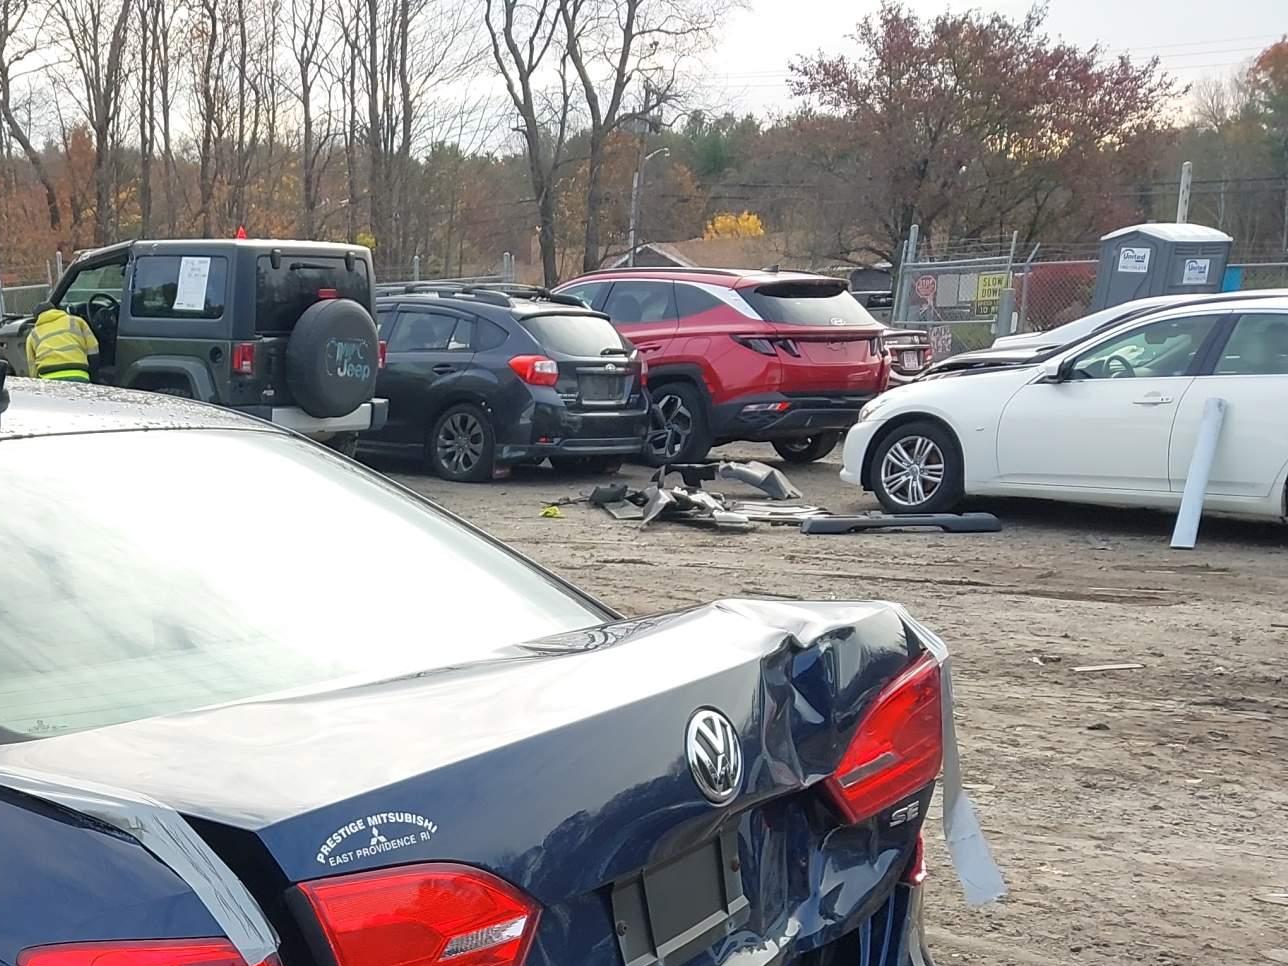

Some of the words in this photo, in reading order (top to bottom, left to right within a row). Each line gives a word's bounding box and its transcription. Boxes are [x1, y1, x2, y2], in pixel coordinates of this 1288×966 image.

[982, 276, 1004, 287] SLOW
[336, 358, 371, 382] Jeep
[888, 800, 920, 828] SE
[316, 818, 366, 865] PRESTIGE
[366, 811, 439, 834] MITSUBISHI
[328, 851, 355, 867] EAST
[355, 834, 417, 860] PROVIDENCE
[419, 830, 432, 842] RI
